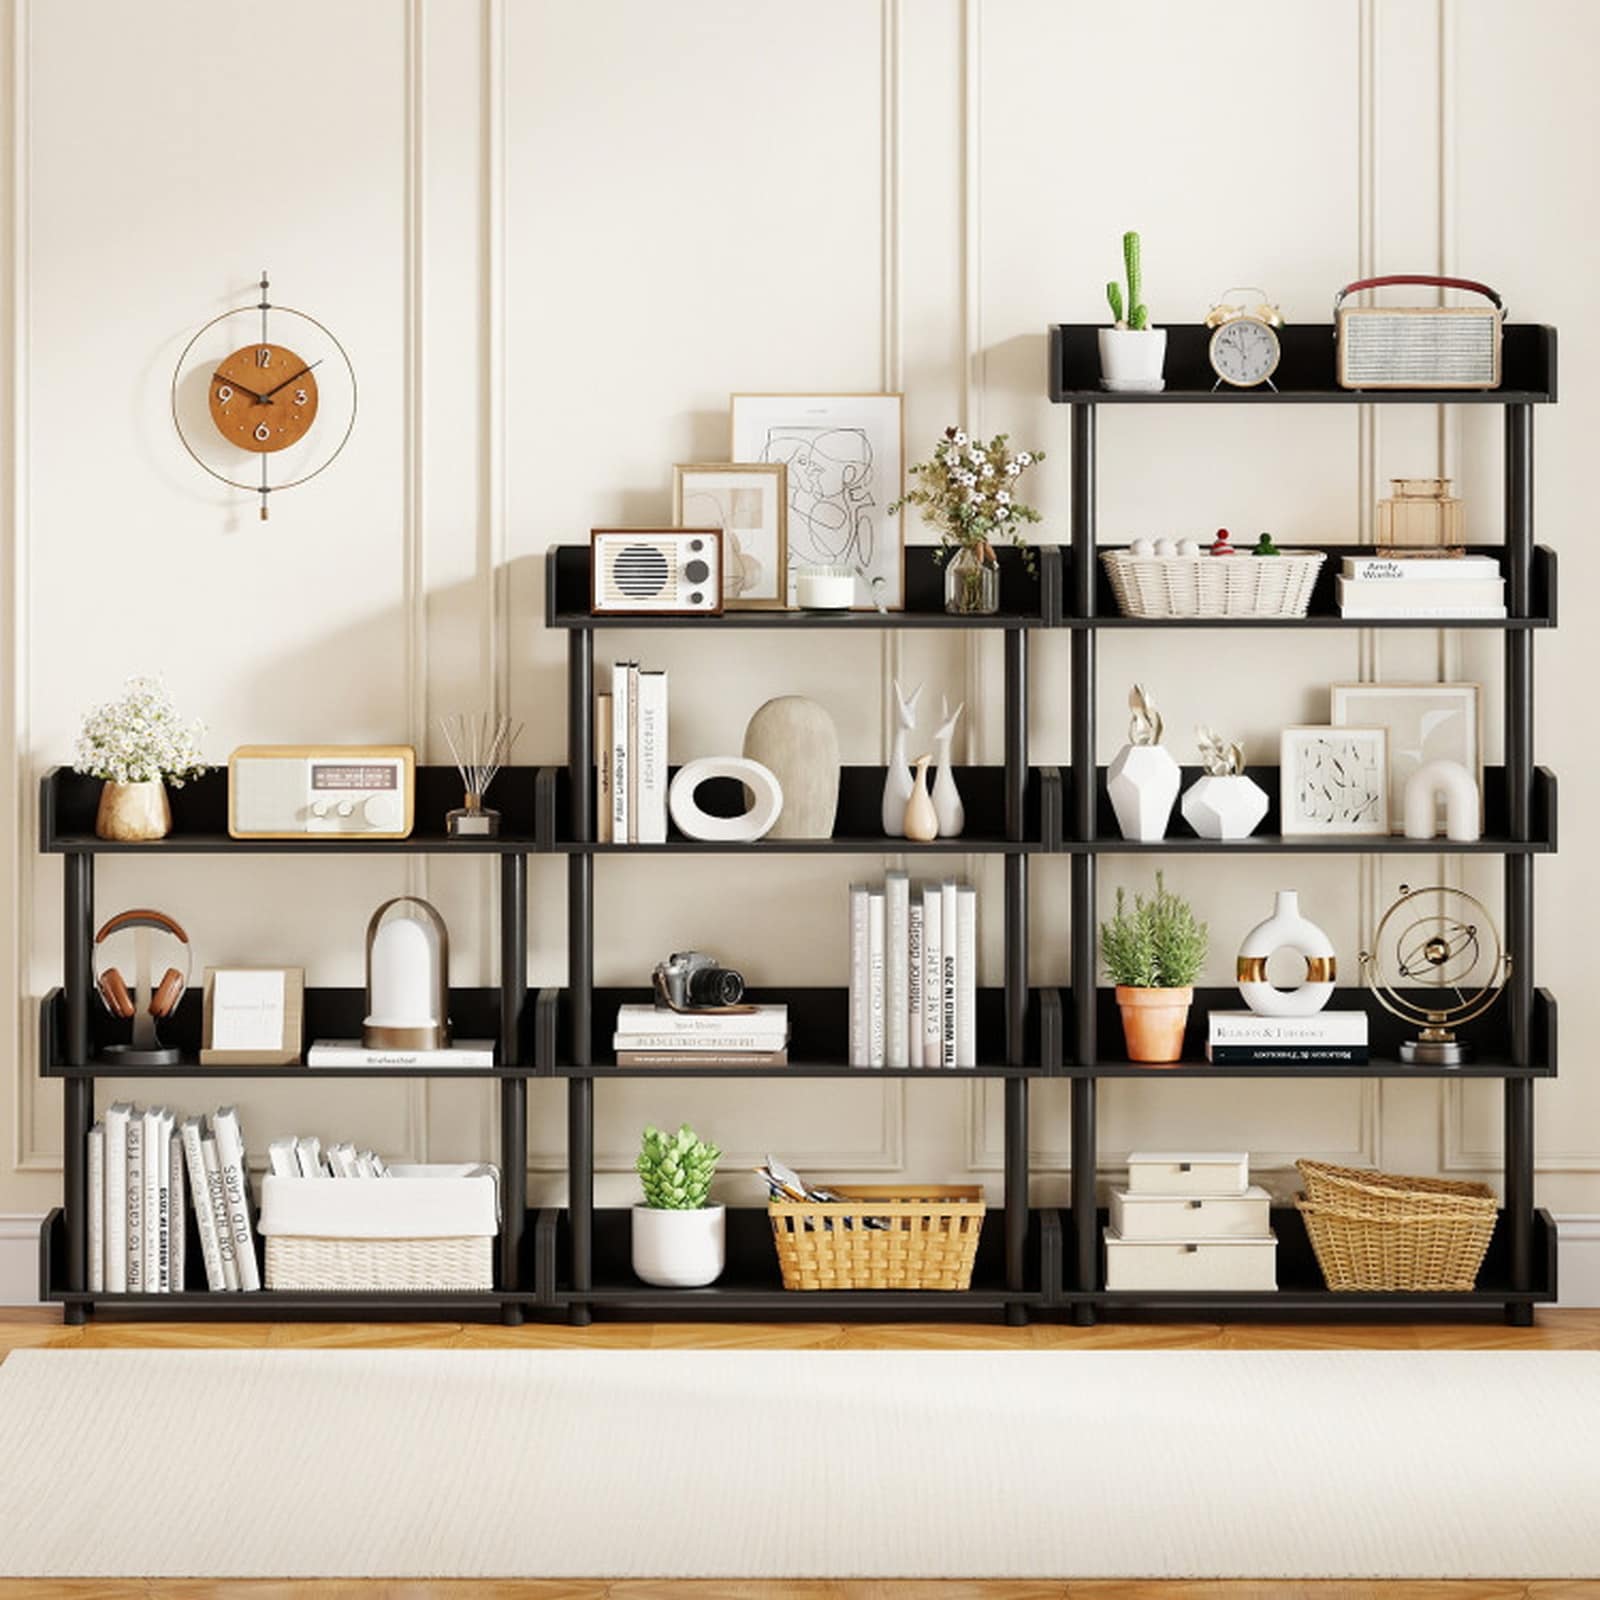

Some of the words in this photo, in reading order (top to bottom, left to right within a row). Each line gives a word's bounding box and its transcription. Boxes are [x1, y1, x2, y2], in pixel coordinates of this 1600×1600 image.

[256, 348, 271, 368] 12
[218, 385, 234, 405] 9
[293, 389, 308, 406] 3
[255, 421, 270, 441] 6
[1367, 562, 1398, 572] Andy
[928, 945, 939, 986] SAME
[945, 956, 954, 986] 2020
[945, 987, 954, 999] IN
[928, 995, 939, 1034] SAME
[945, 1002, 954, 1042] WORLD
[945, 1044, 954, 1064] THE
[128, 1128, 140, 1160] fish
[224, 1165, 242, 1204] CARS
[128, 1185, 140, 1228] catch
[232, 1213, 248, 1244] OLD
[129, 1235, 140, 1251] to
[128, 1260, 140, 1285] How
